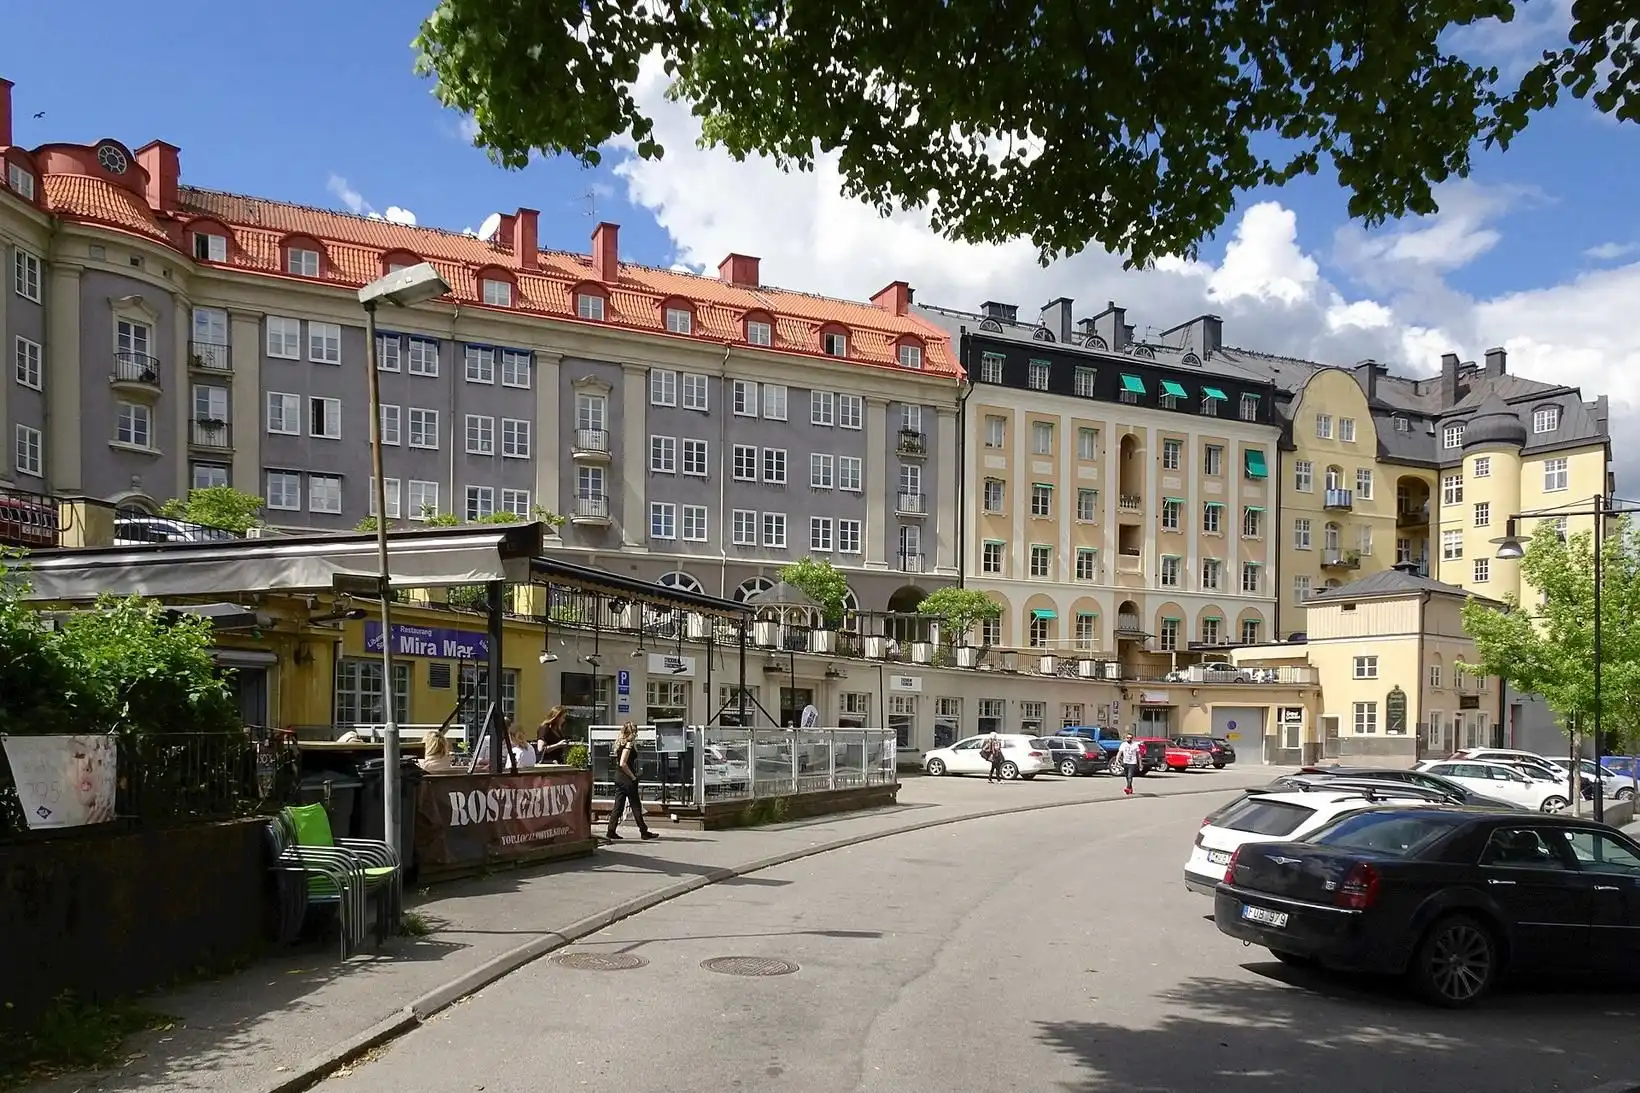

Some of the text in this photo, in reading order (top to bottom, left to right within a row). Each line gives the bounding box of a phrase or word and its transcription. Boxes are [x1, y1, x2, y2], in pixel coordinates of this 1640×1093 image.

[400, 625, 432, 637] Restaurang
[400, 635, 437, 656] Mira
[443, 639, 474, 659] Mar
[621, 671, 627, 685] P
[1269, 911, 1286, 925] 979
